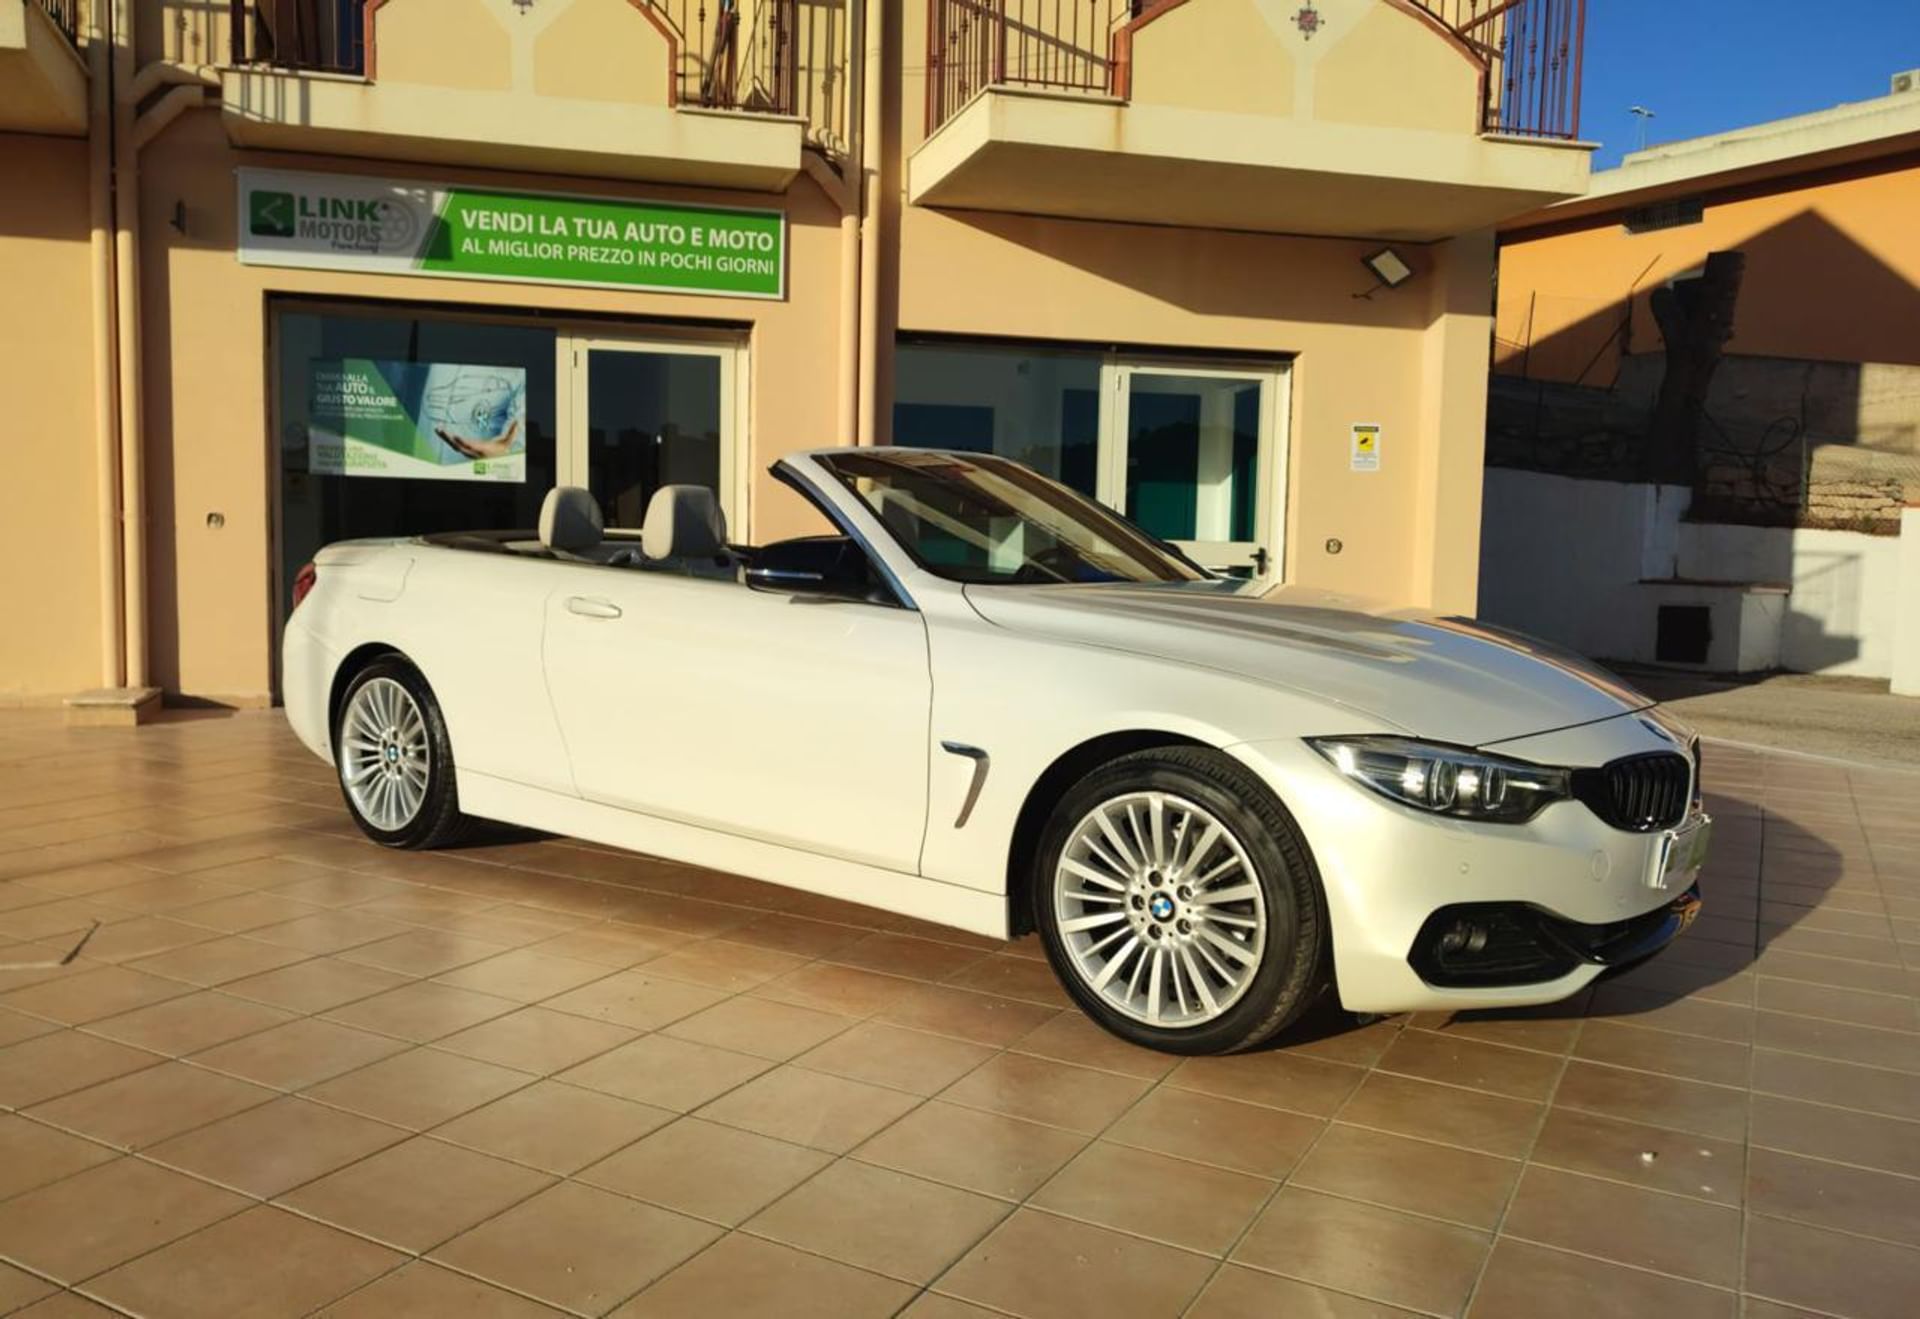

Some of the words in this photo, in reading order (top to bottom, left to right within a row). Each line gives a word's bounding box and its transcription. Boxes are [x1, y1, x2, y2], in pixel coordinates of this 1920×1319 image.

[300, 196, 380, 221] LINK
[300, 220, 382, 243] MOTORS
[461, 209, 533, 233] VENDI
[540, 215, 567, 236] LA
[573, 217, 618, 240] TUA
[624, 222, 685, 245] AUTO
[691, 227, 703, 246] E
[708, 229, 773, 251] MOTO
[462, 238, 485, 254] AL
[488, 240, 563, 260] MIGLIOR
[568, 245, 634, 265] PREZZO
[638, 249, 655, 267] IN
[660, 252, 712, 271] POCHI
[716, 256, 774, 275] GIORNI
[336, 381, 368, 395] AUTO
[356, 396, 398, 407] VALORE
